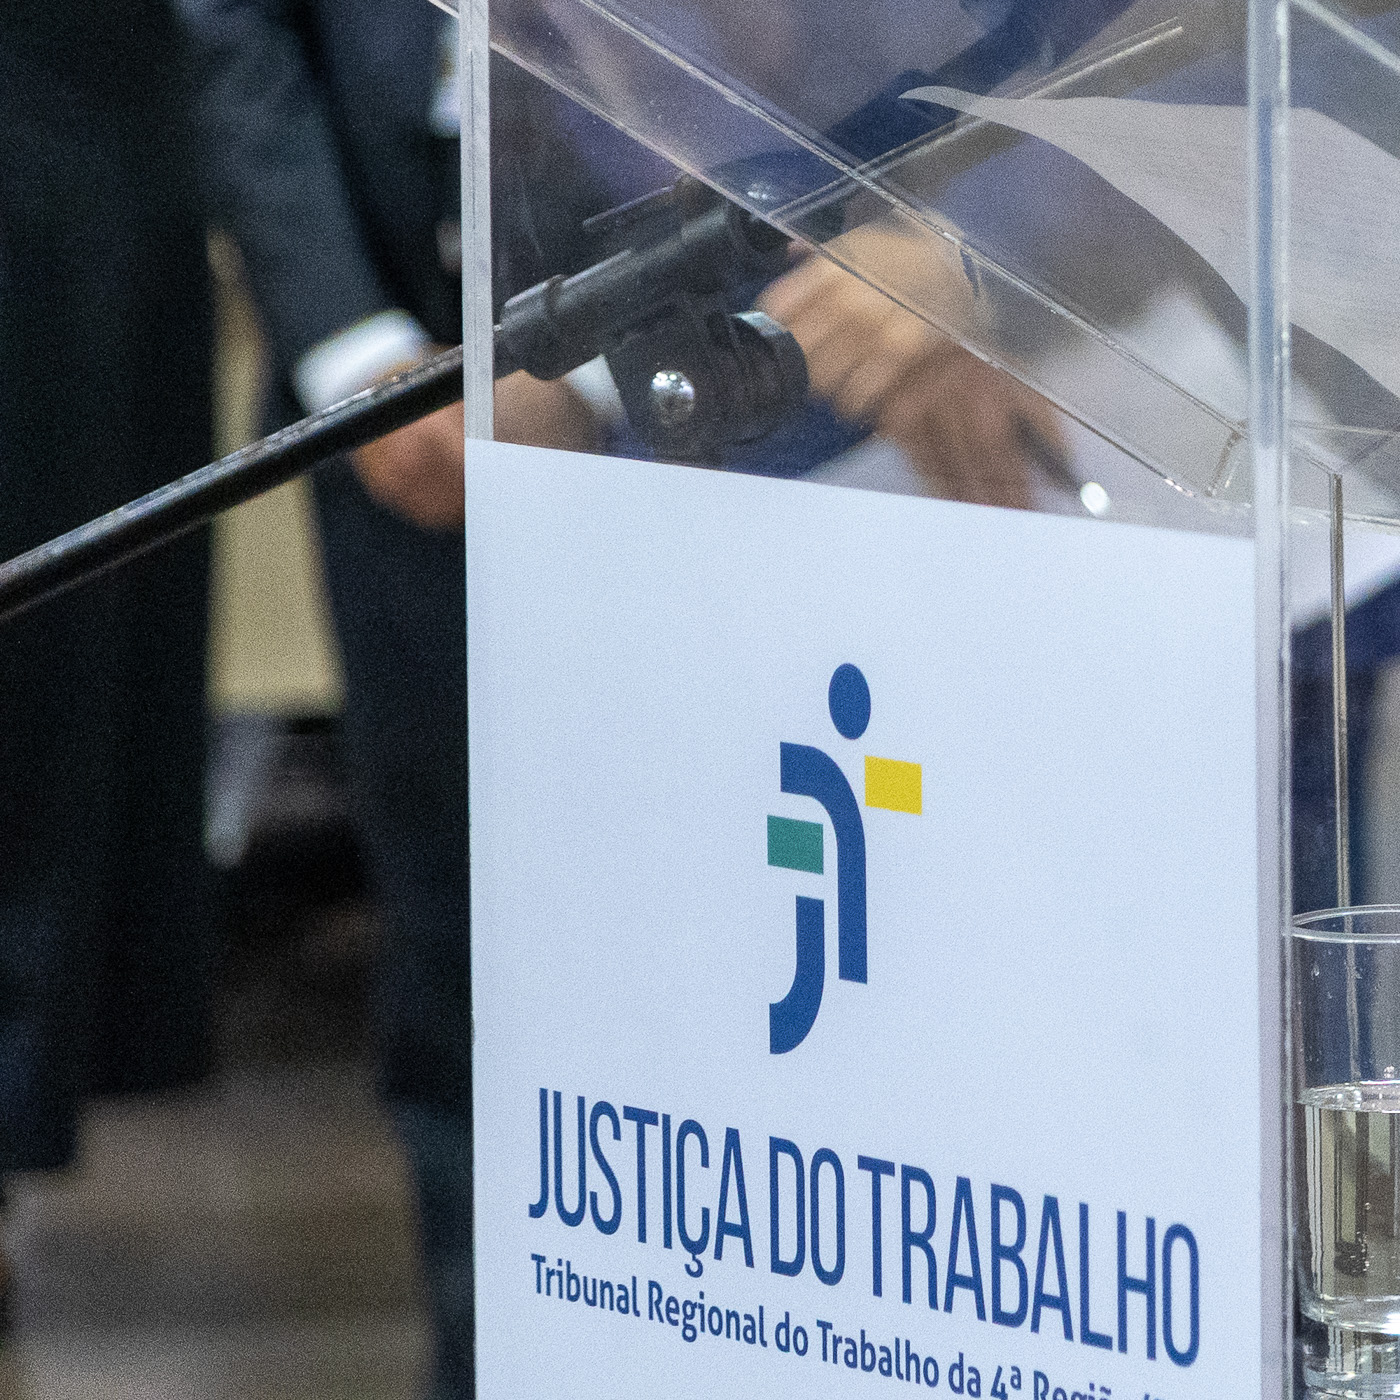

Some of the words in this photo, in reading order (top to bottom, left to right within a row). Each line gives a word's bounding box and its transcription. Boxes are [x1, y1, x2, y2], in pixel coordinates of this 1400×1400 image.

[528, 1087, 755, 1279] JUSTIÇA
[768, 1136, 846, 1287] DO
[857, 1154, 1200, 1368] TRABALHO
[531, 1253, 640, 1318] Tribunal
[648, 1280, 768, 1348] Regional
[774, 1311, 809, 1357] do
[816, 1319, 940, 1388] Trabalho
[948, 1351, 982, 1399] da
[990, 1364, 1022, 1400] 4ª
